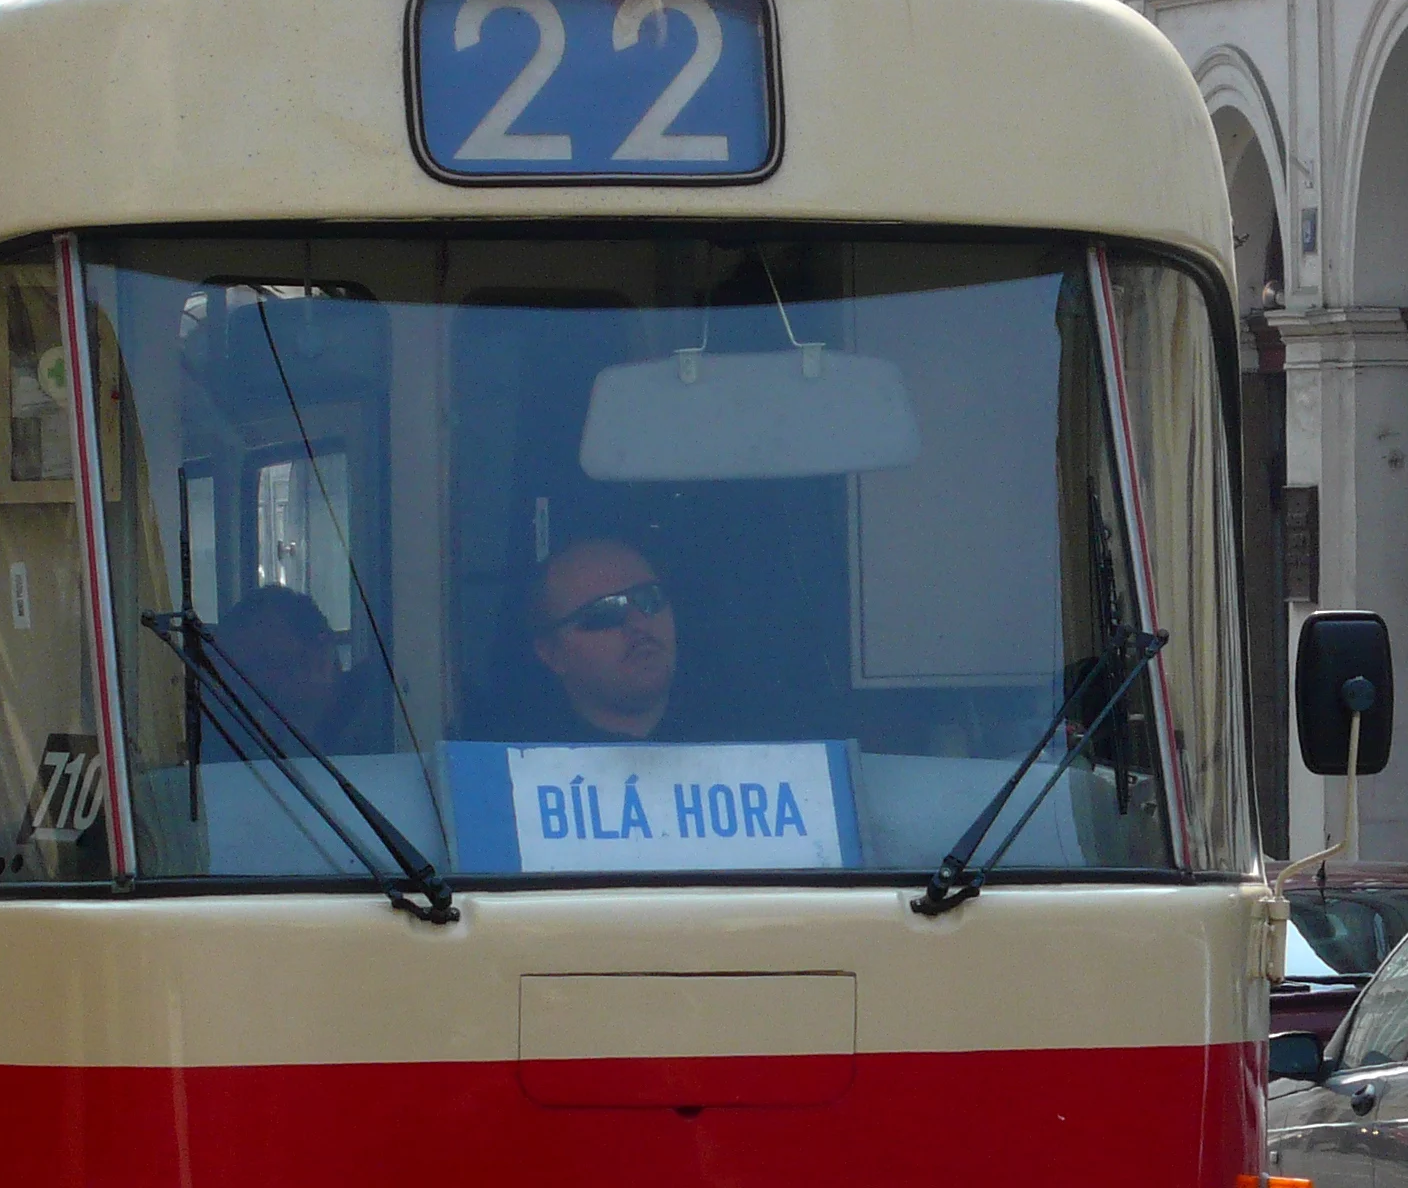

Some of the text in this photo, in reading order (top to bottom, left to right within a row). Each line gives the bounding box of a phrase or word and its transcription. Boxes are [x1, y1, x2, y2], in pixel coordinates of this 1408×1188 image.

[32, 751, 106, 831] 710
[537, 774, 808, 840] BÍLÁ HORA
